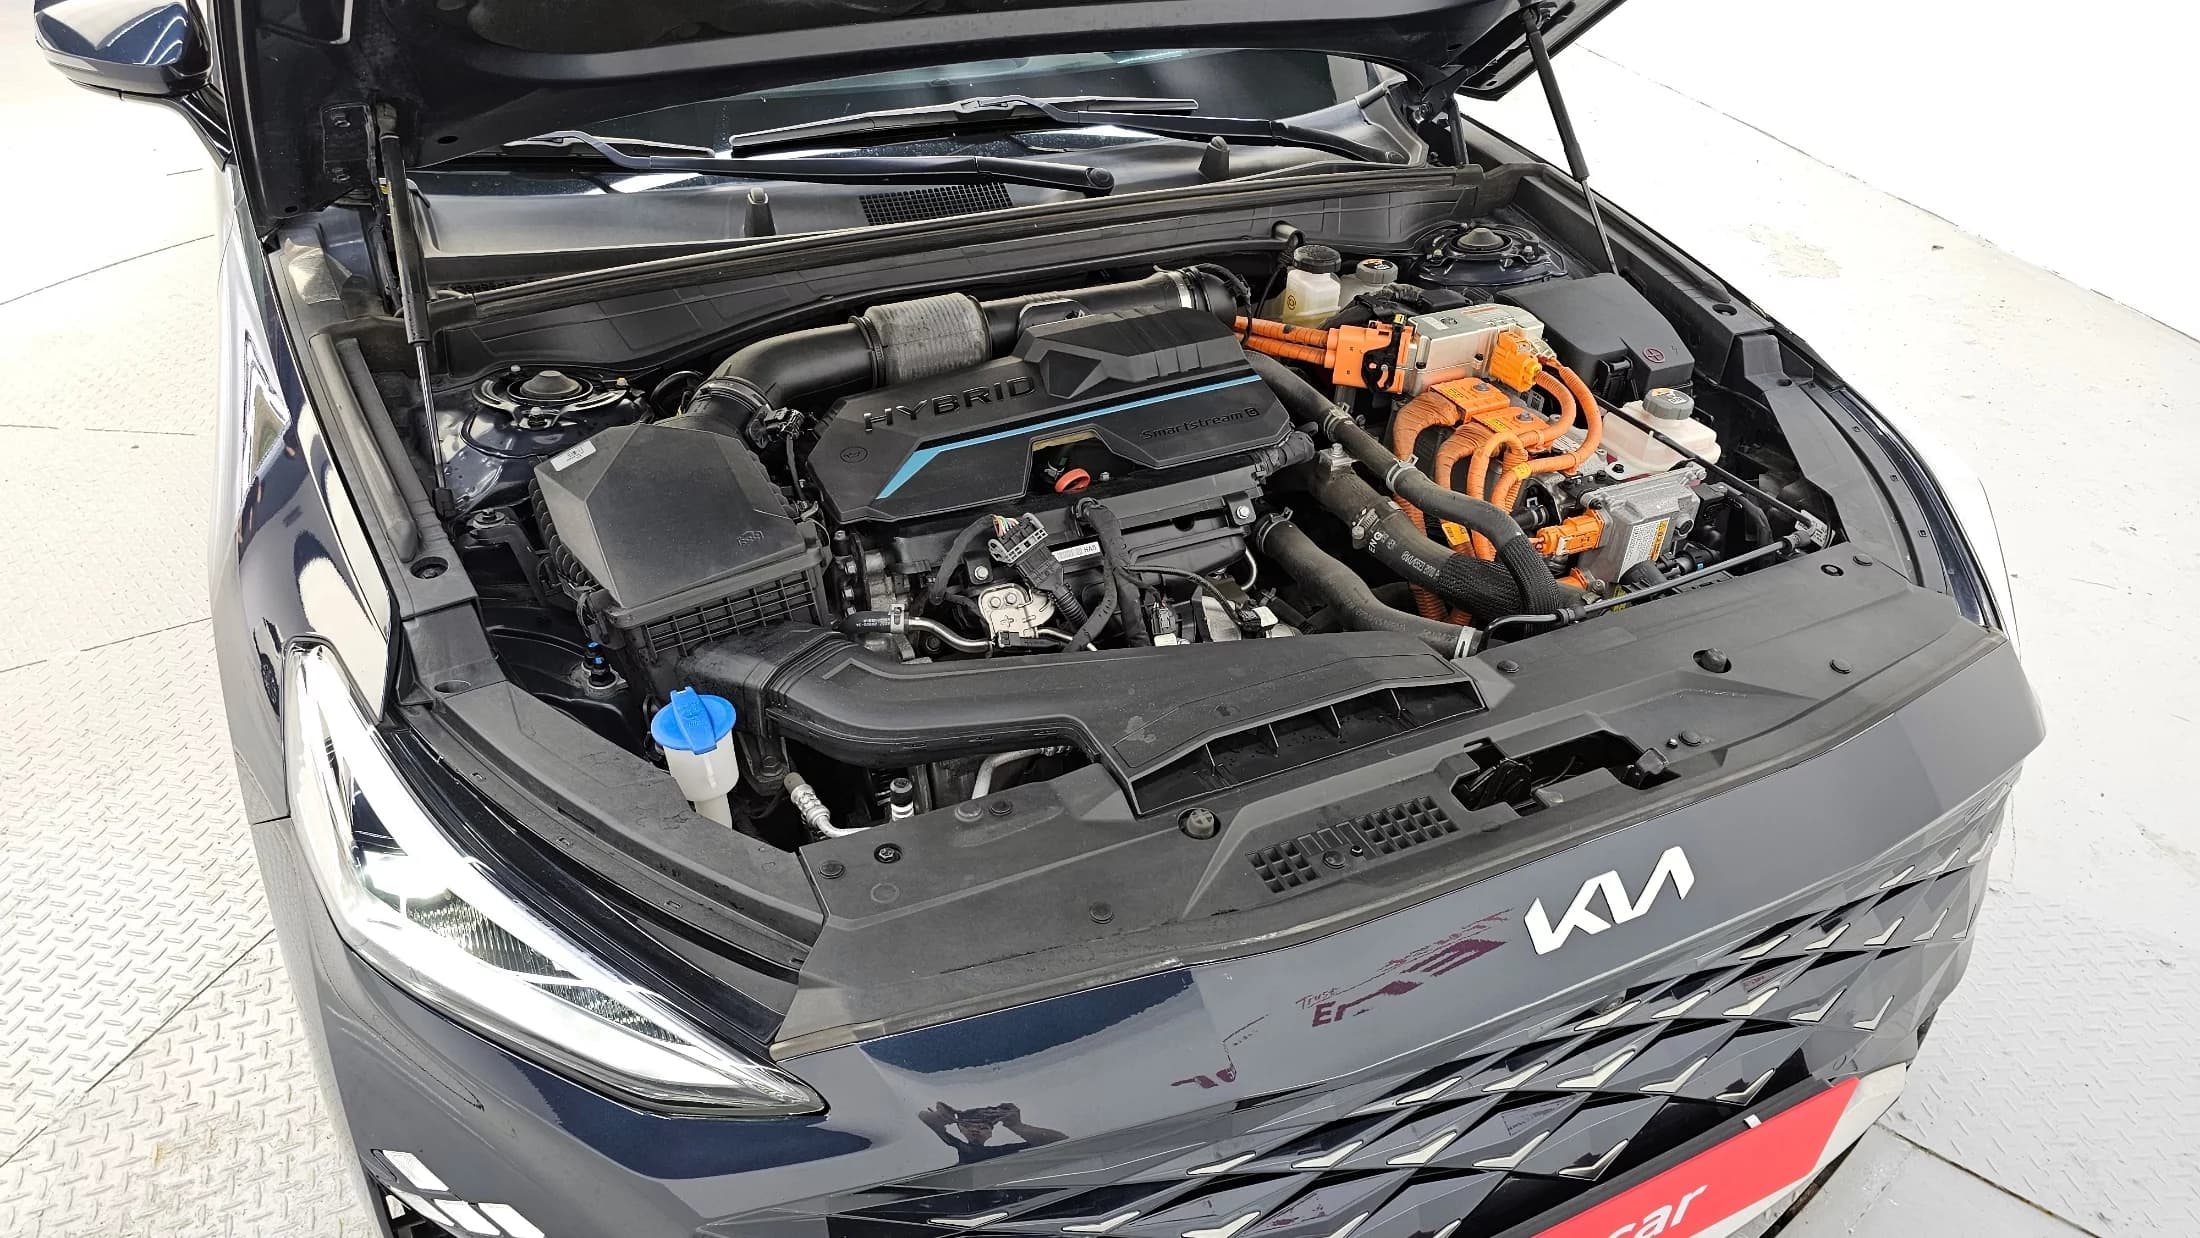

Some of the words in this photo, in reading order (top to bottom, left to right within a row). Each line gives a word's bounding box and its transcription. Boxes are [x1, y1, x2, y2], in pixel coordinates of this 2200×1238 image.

[863, 376, 1036, 432] HYBRID
[1142, 411, 1243, 440] Smartstream
[1523, 845, 1695, 955] KIA
